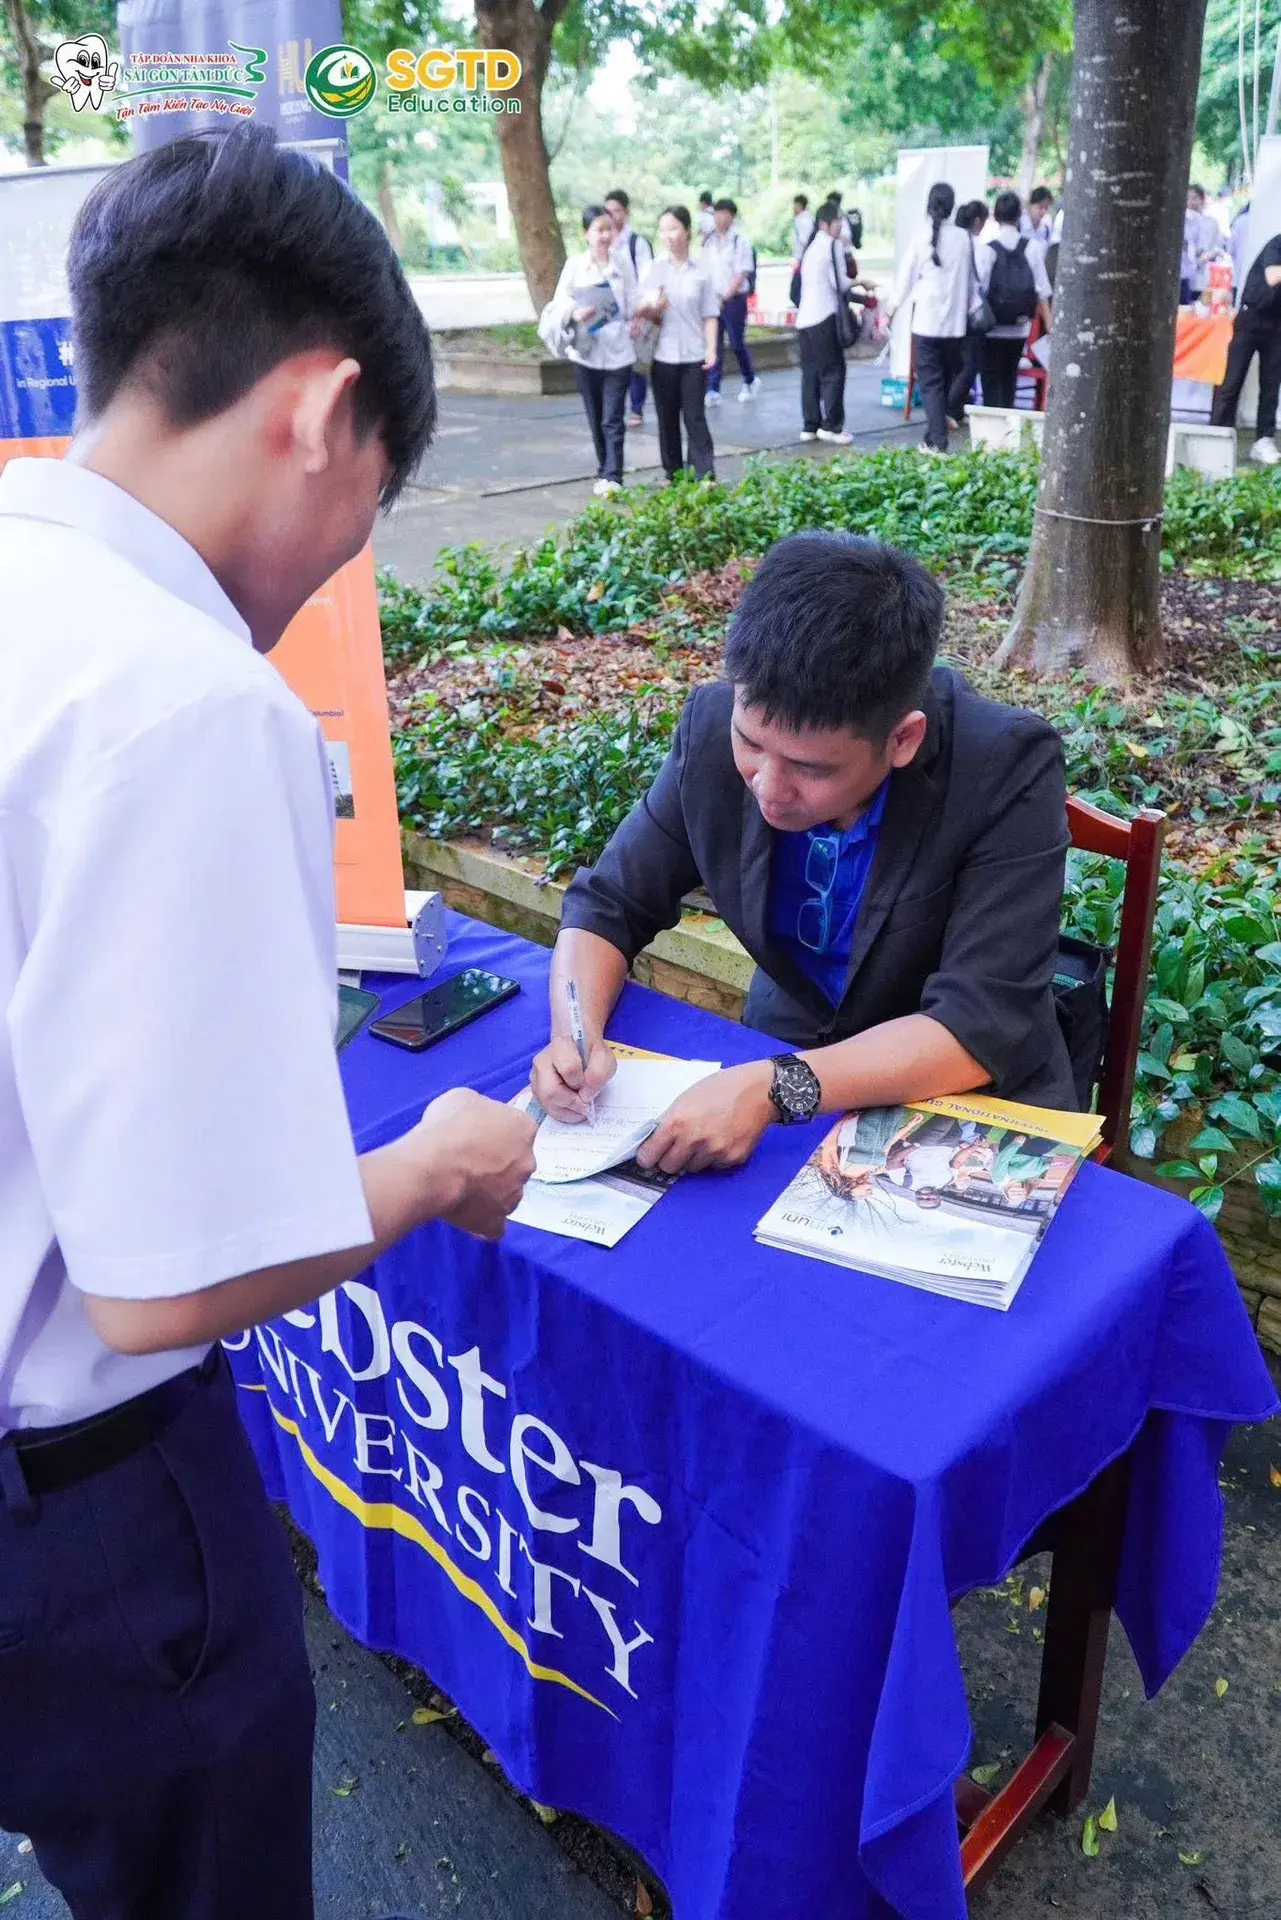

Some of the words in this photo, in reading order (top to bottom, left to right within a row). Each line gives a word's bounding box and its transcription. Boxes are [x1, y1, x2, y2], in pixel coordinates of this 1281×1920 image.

[26, 375, 68, 389] Regional
[947, 1102, 1048, 1134] INTERNATIONAL
[937, 1257, 991, 1273] Webster
[282, 1280, 662, 1588] bster
